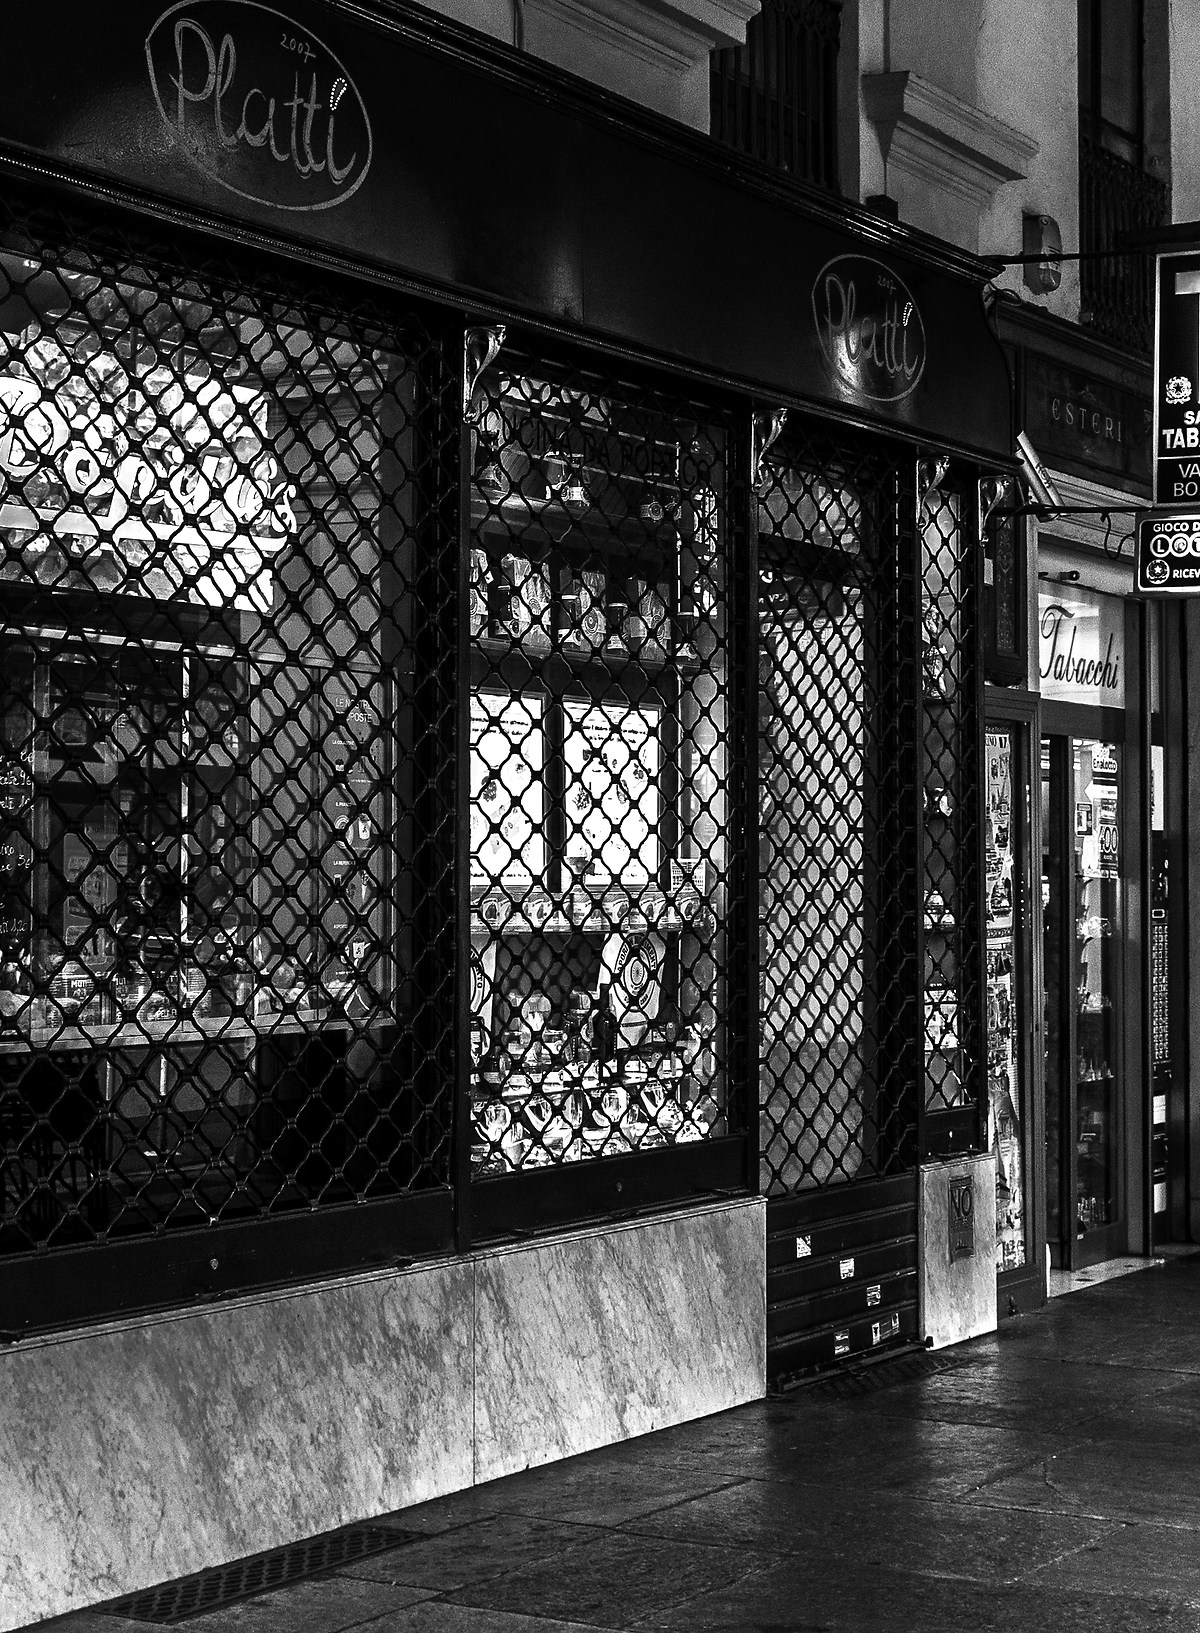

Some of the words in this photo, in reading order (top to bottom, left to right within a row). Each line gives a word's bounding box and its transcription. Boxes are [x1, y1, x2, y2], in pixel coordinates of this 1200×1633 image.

[279, 33, 317, 64] 2007
[168, 18, 356, 185] Platti
[823, 273, 919, 380] Platti
[1051, 397, 1123, 443] ESTERI
[1153, 522, 1190, 533] GIOCO
[1040, 604, 1120, 689] Tabacchi
